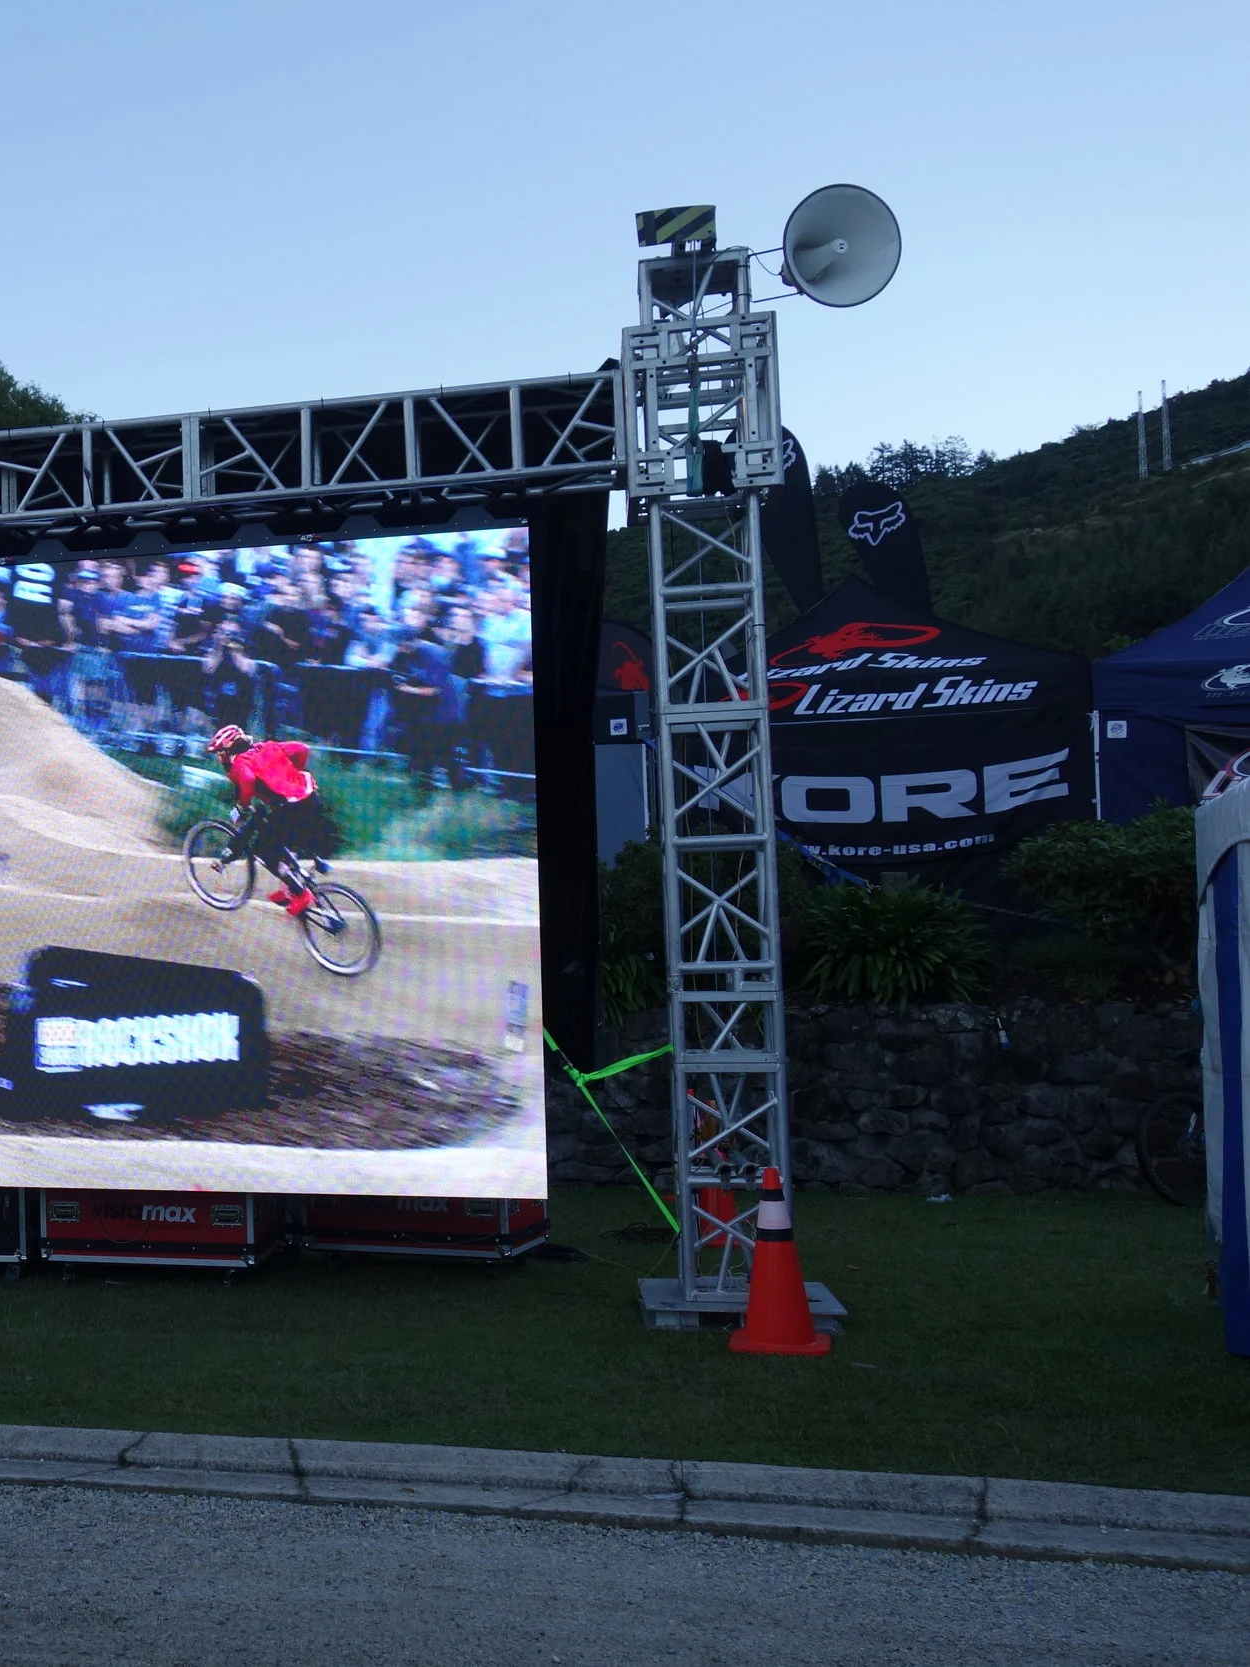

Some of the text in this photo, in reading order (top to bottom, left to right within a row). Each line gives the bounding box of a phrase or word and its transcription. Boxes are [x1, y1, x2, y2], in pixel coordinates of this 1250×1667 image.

[867, 652, 988, 669] Skins
[793, 675, 1039, 716] Lizard Skins
[802, 833, 995, 857] w.kore-usa.com
